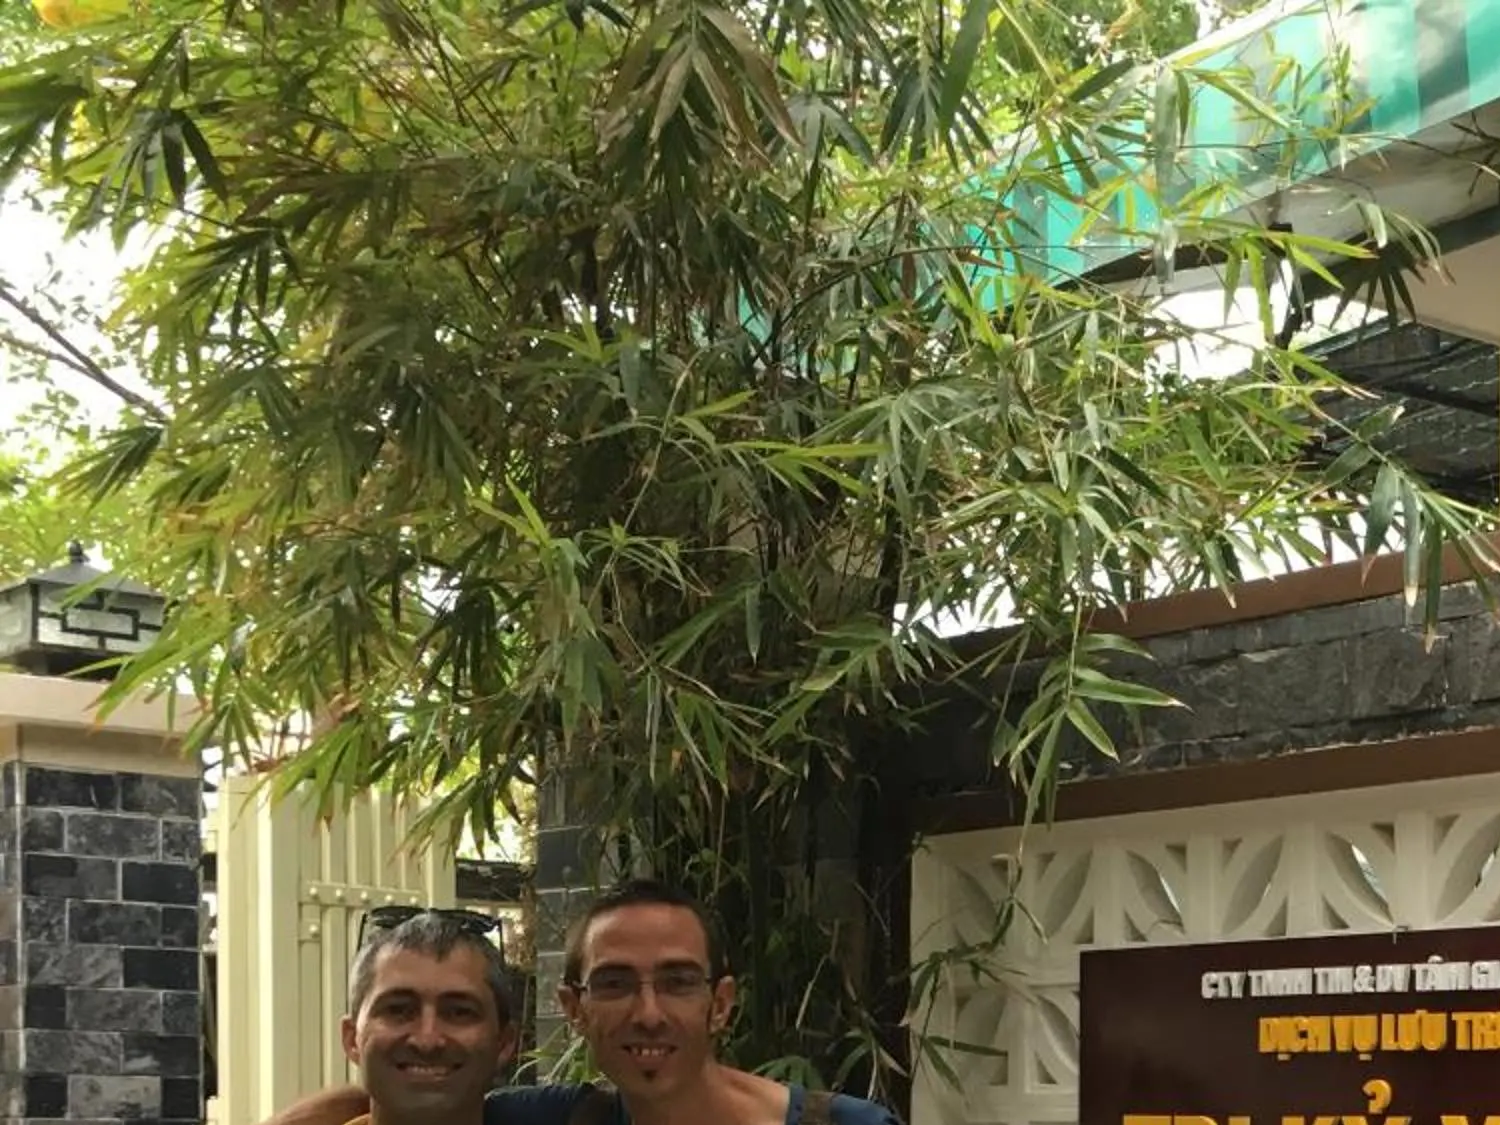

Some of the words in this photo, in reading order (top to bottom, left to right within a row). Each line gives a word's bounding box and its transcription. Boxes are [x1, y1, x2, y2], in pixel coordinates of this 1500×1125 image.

[1201, 971, 1247, 999] CTY
[1259, 1016, 1332, 1061] DỊCH
[1333, 1015, 1379, 1061] VỤ
